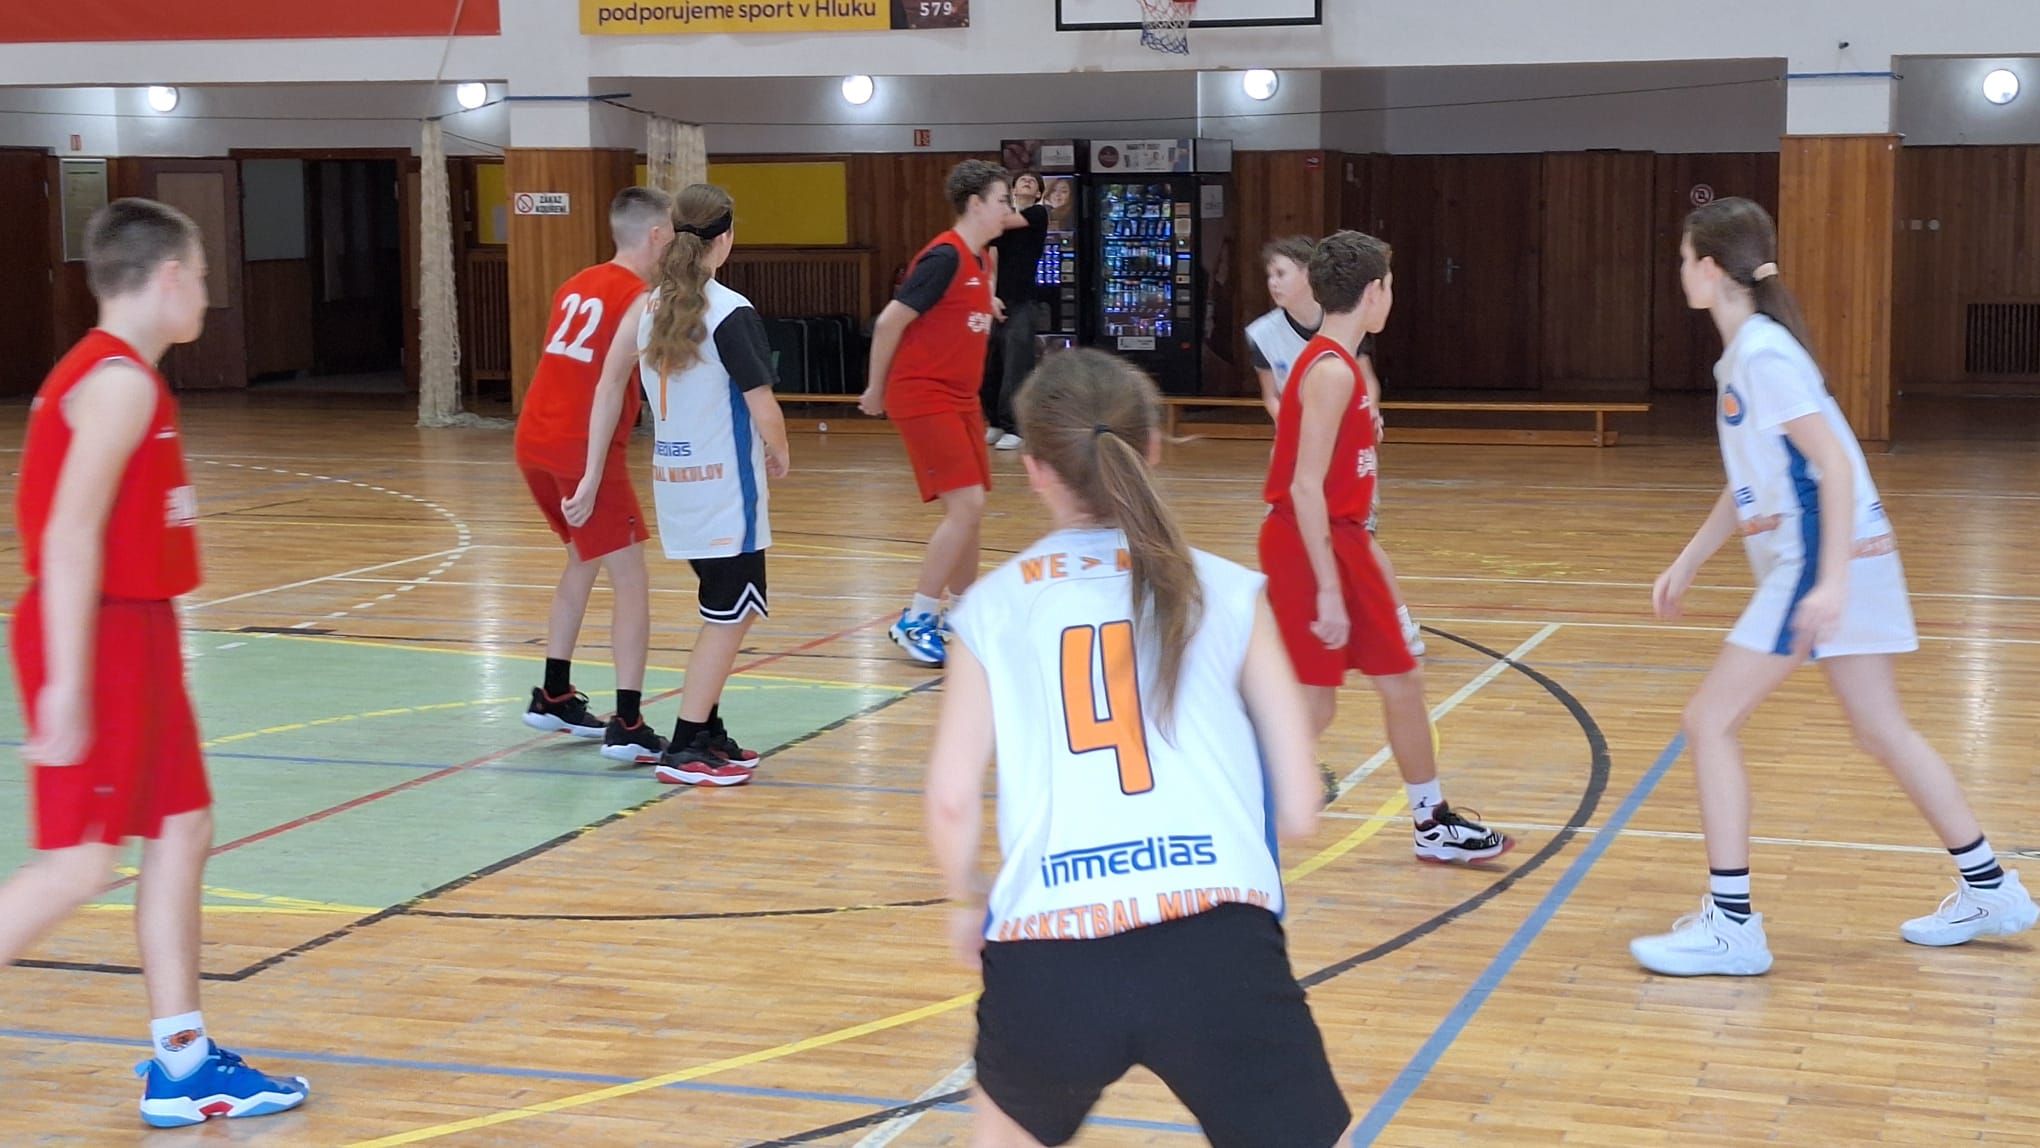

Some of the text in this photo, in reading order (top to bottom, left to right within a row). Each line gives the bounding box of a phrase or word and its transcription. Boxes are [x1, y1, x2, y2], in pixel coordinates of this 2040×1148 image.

[598, 0, 876, 26] podporujeme sport v Hluku
[919, 2, 952, 16] 579
[547, 293, 604, 363] 22
[1018, 552, 1068, 584] WE
[1060, 619, 1155, 796] 4
[1040, 834, 1217, 889] inmedias
